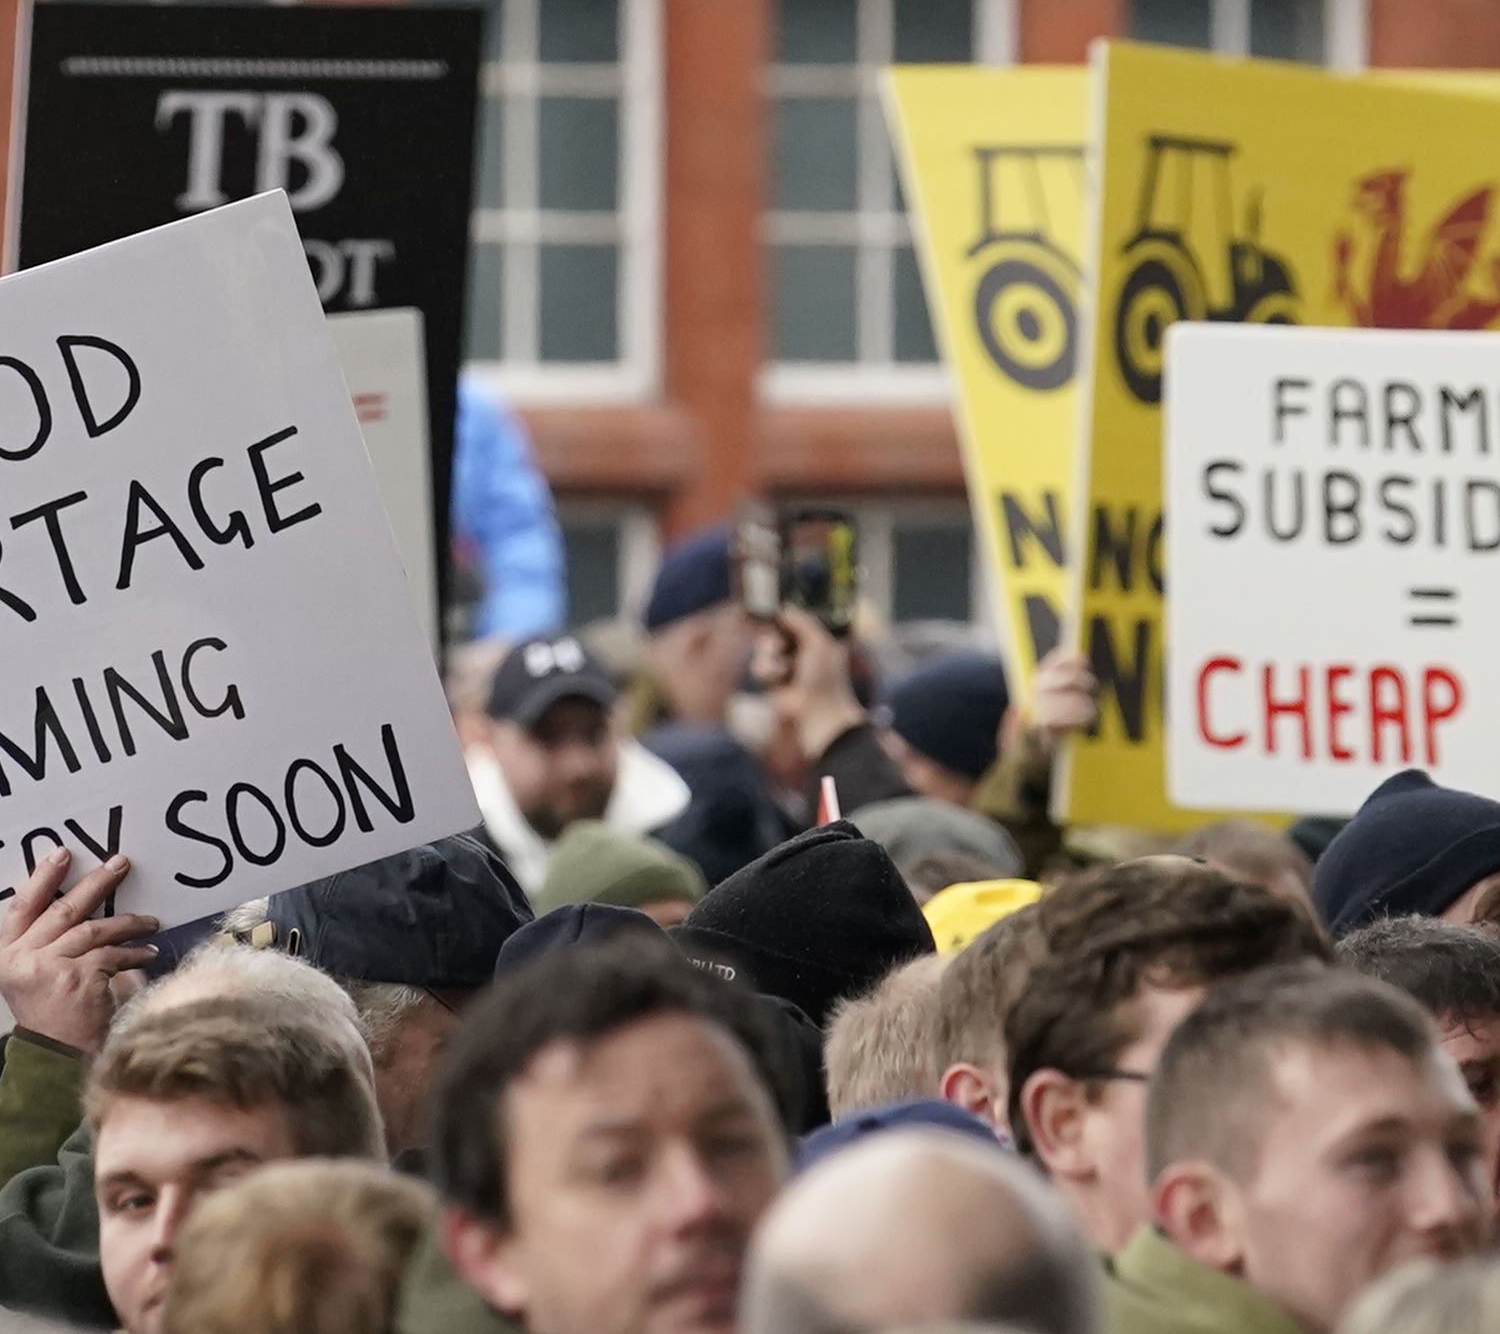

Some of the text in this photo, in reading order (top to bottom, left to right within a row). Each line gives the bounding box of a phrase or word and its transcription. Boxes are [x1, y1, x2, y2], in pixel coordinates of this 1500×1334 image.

[155, 89, 346, 213] TB
[1197, 657, 1463, 766] CHEAP
[164, 723, 418, 890] SOON
